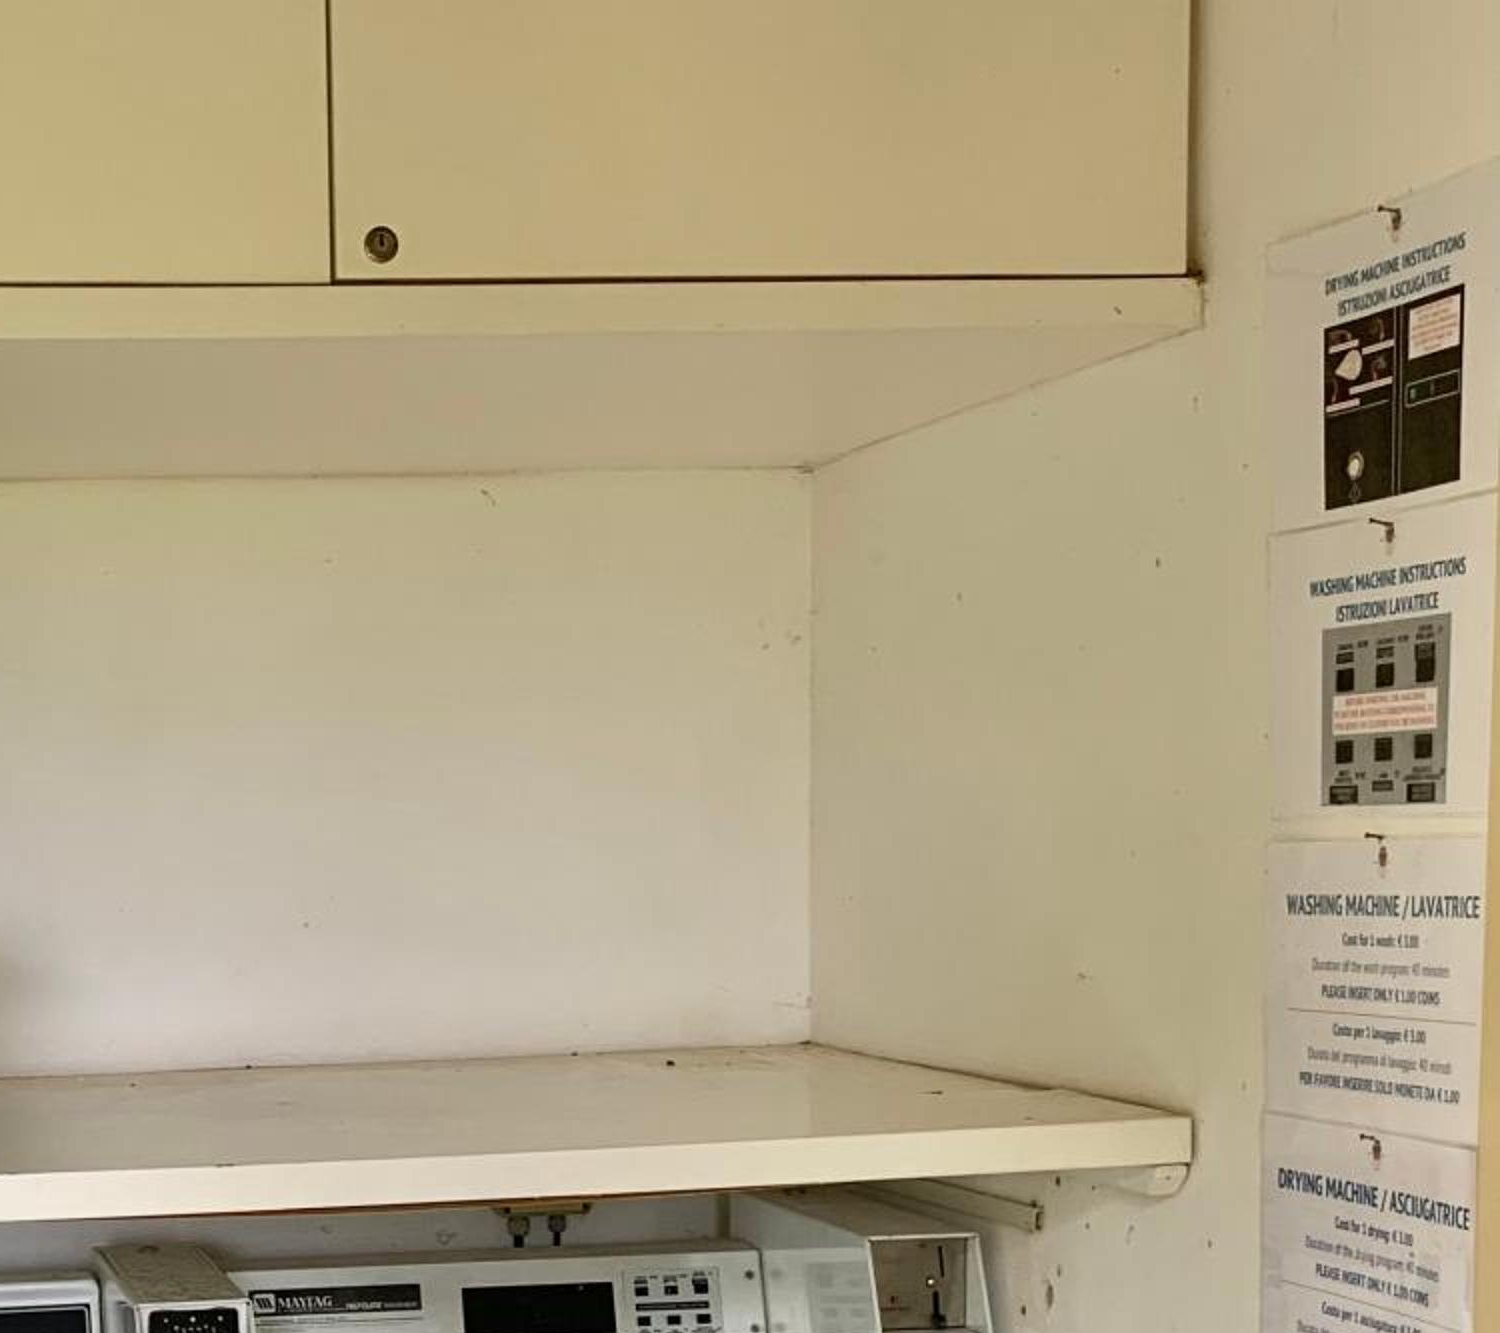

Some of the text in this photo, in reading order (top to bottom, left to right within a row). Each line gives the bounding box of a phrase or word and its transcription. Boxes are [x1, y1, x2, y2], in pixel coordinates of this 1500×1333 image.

[1325, 231, 1466, 296] DRYING MACHINE INSTRUCTIONS
[1310, 556, 1467, 596] WASHING MACHINE INSTRUCTIONS
[1336, 592, 1439, 622] ISTRUZIONI LAVATRICE
[1286, 894, 1343, 915] WASHING
[1345, 894, 1399, 917] MACHINE
[1411, 895, 1480, 918] LAVATRICE
[1278, 1167, 1470, 1231] DRYING MACHINE / ASCIUGATRICE
